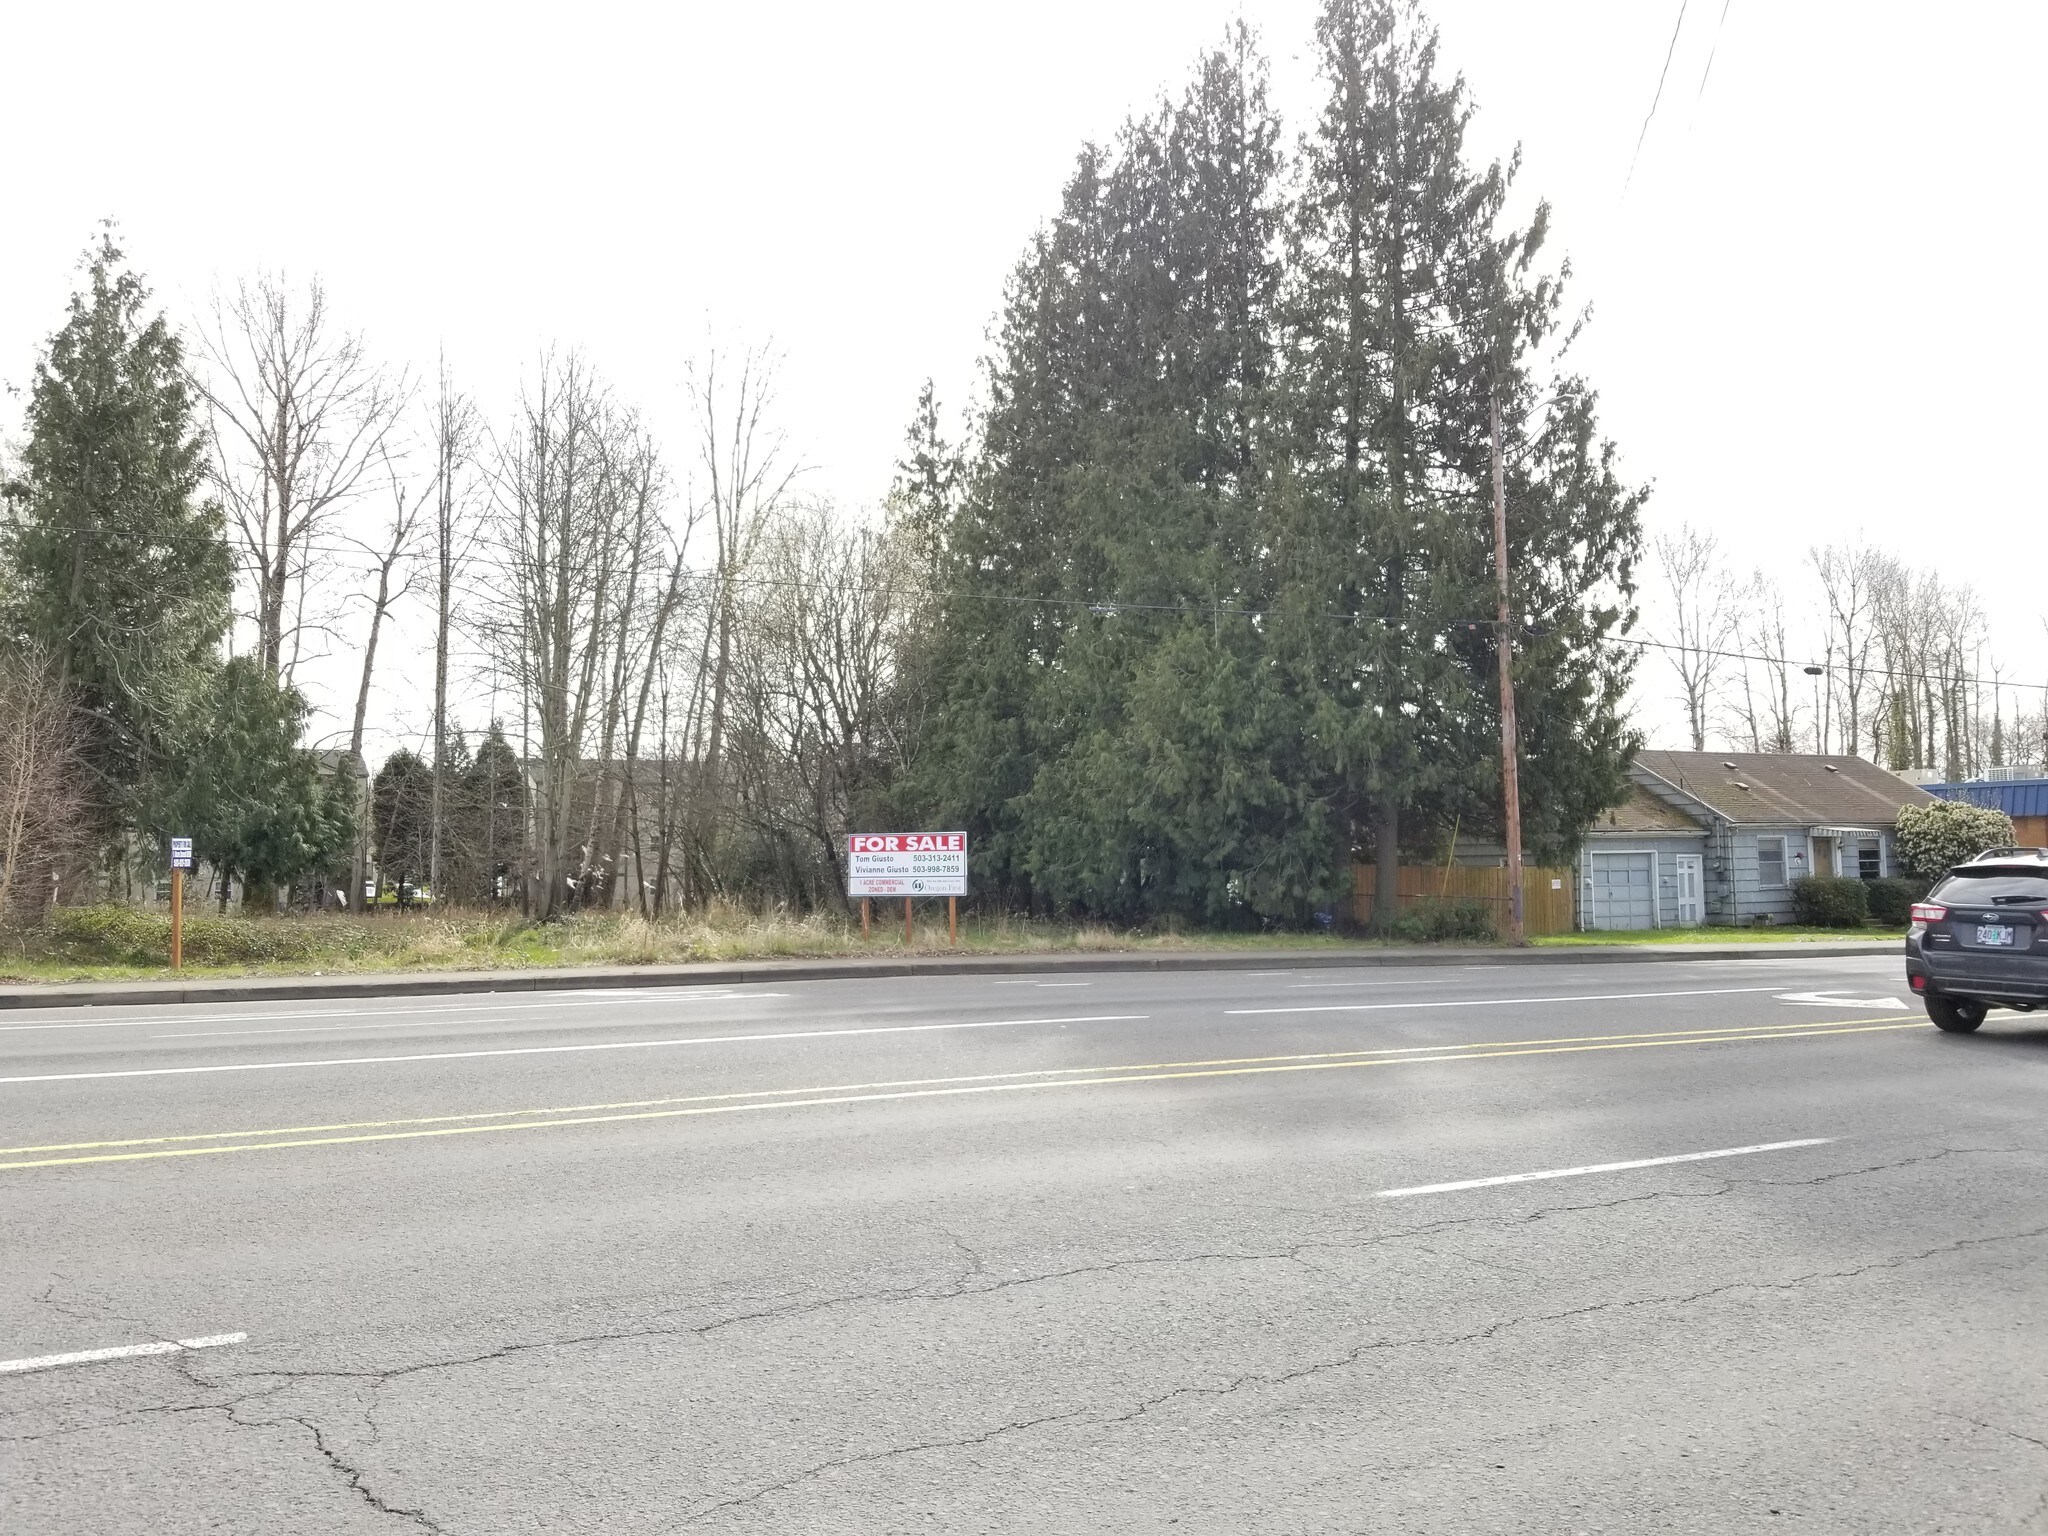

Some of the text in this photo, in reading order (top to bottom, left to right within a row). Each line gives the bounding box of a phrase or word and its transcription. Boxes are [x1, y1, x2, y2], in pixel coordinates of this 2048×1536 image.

[854, 836, 960, 852] FOR SALE
[913, 854, 960, 862] 503-313-2411
[886, 865, 909, 873] Giusto
[912, 865, 960, 873] 503-998-7859
